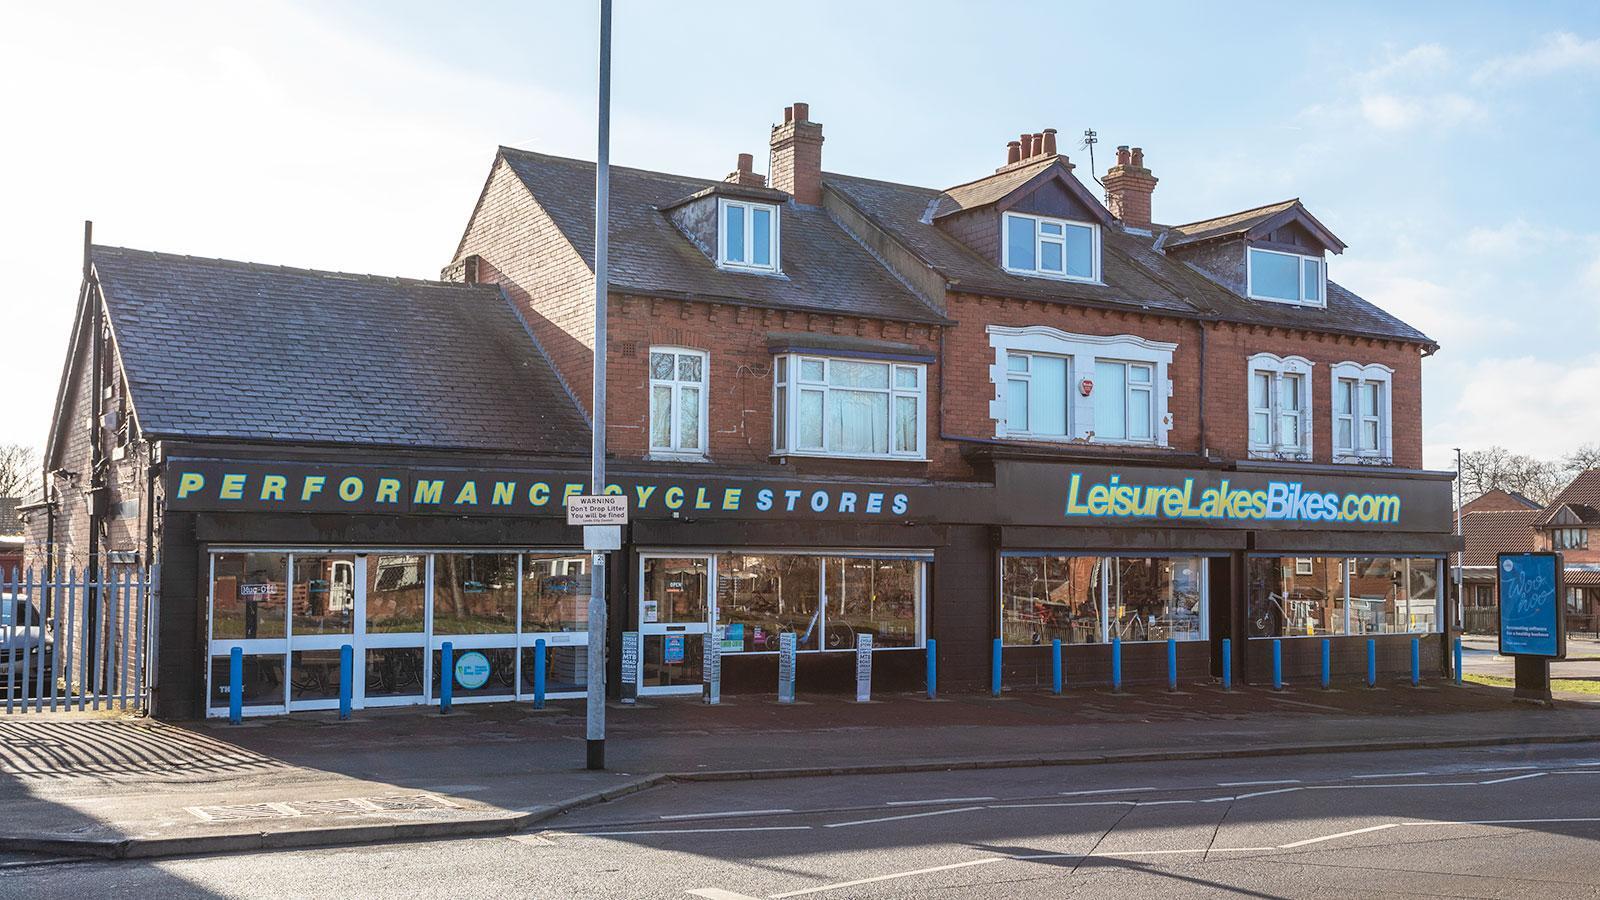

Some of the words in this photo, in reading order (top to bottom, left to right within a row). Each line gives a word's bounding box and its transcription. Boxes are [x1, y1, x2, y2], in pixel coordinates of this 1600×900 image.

[177, 472, 585, 506] PERFORMANCE
[756, 489, 909, 515] STORES
[1065, 472, 1400, 523] LeisureLakesBikes.com
